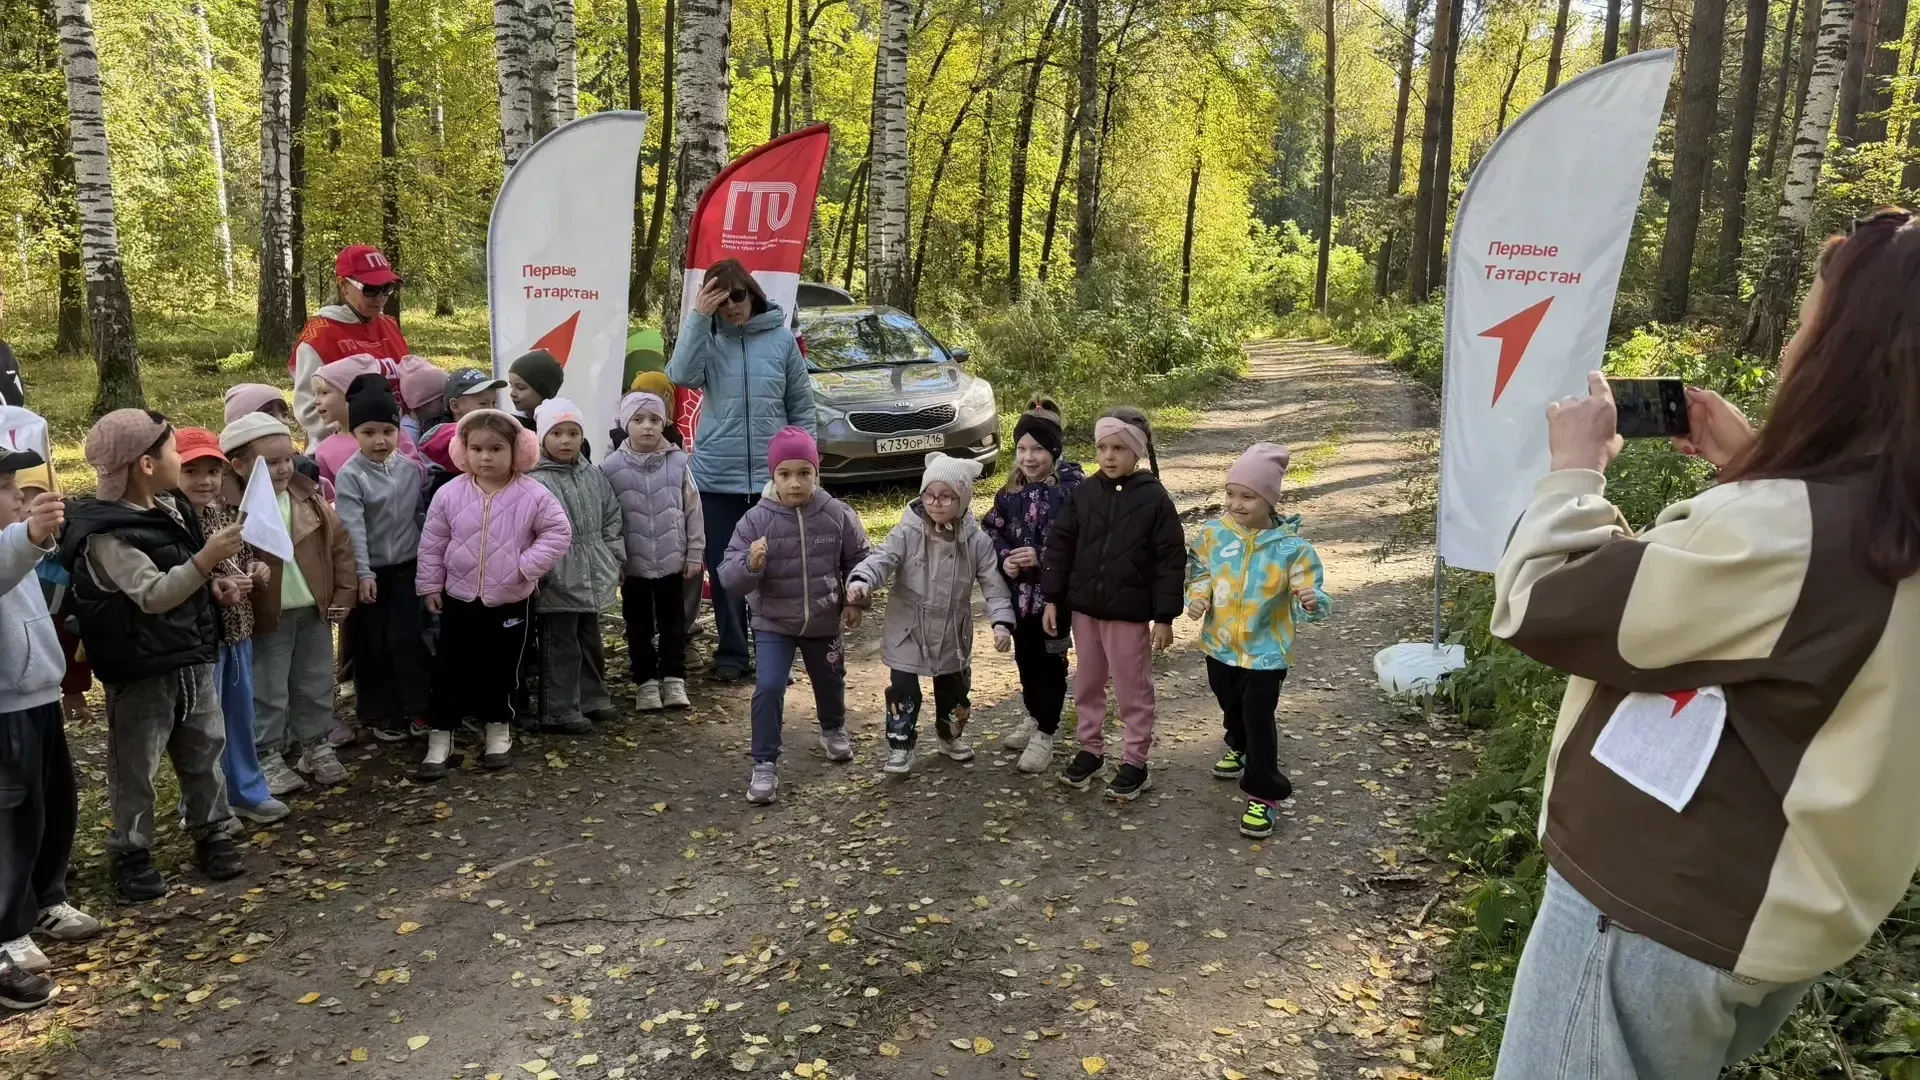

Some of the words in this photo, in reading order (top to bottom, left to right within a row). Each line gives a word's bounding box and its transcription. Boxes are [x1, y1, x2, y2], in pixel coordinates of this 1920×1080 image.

[723, 181, 798, 232] ГТО
[1487, 241, 1559, 260] Первые
[522, 264, 577, 280] Первые
[1484, 265, 1582, 285] Татарстан
[523, 286, 599, 301] Татарстан
[924, 434, 943, 444] 716
